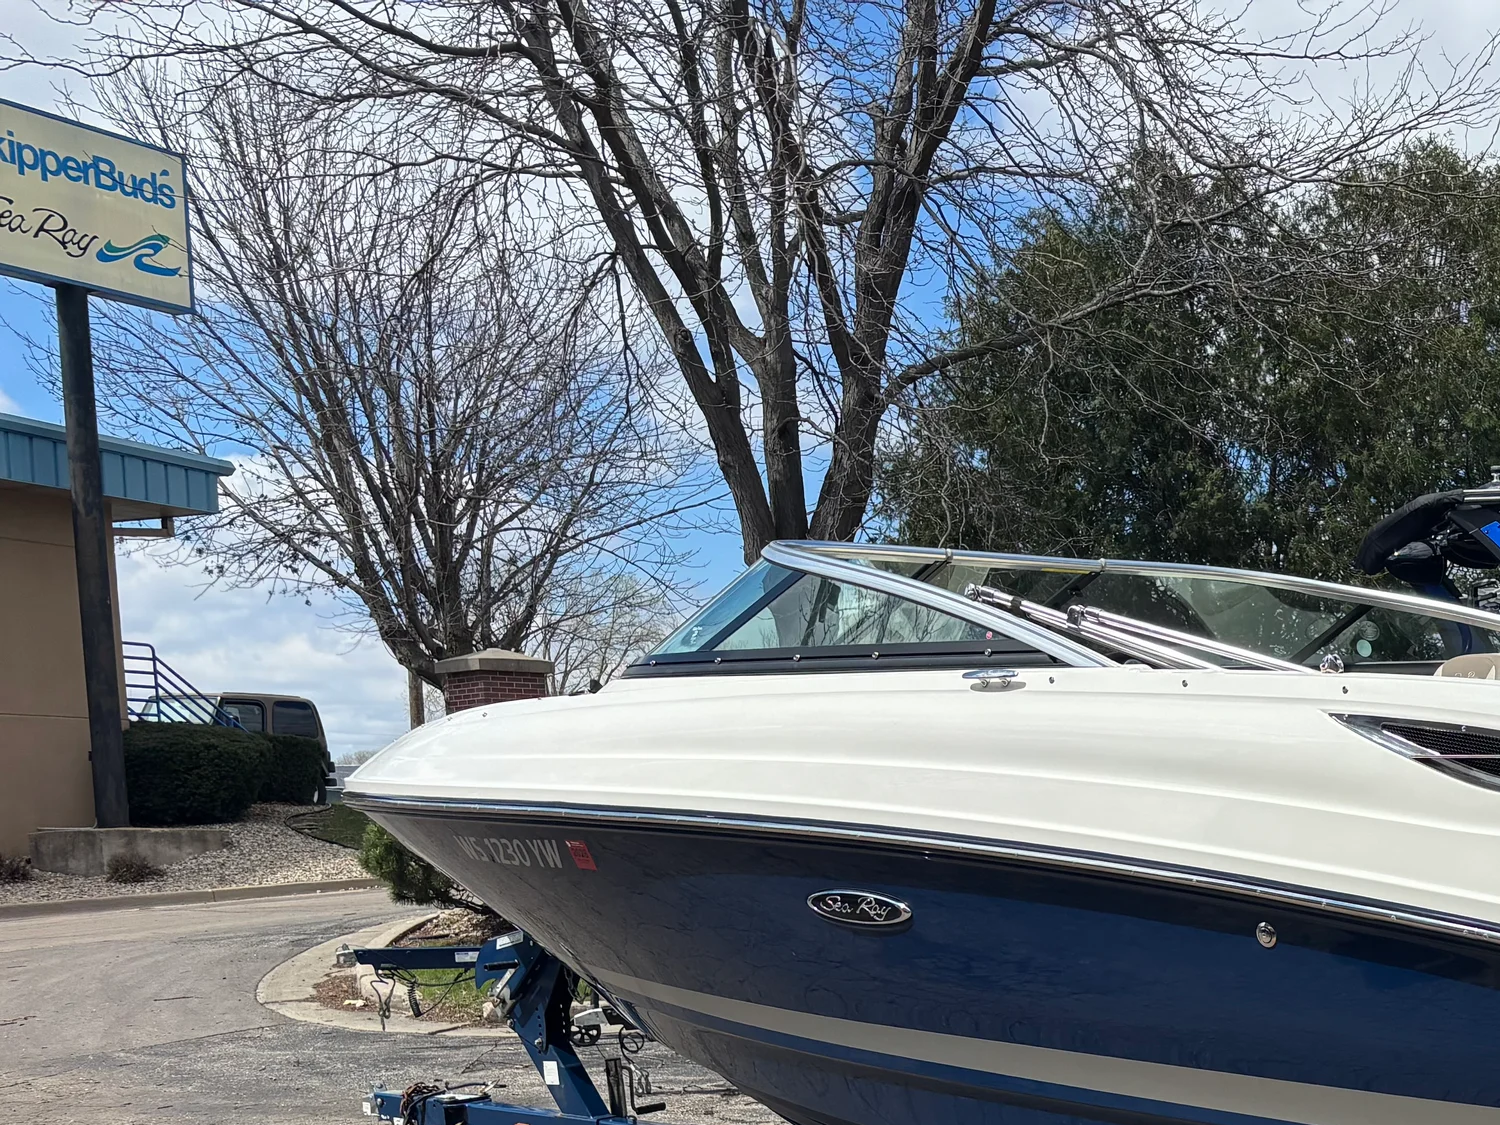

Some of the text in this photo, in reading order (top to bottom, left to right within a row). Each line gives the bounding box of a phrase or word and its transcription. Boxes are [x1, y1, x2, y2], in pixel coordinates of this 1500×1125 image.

[0, 195, 99, 258] ea Ray
[453, 836, 563, 869] WS 1230 YW
[820, 895, 892, 921] Sea Ray
